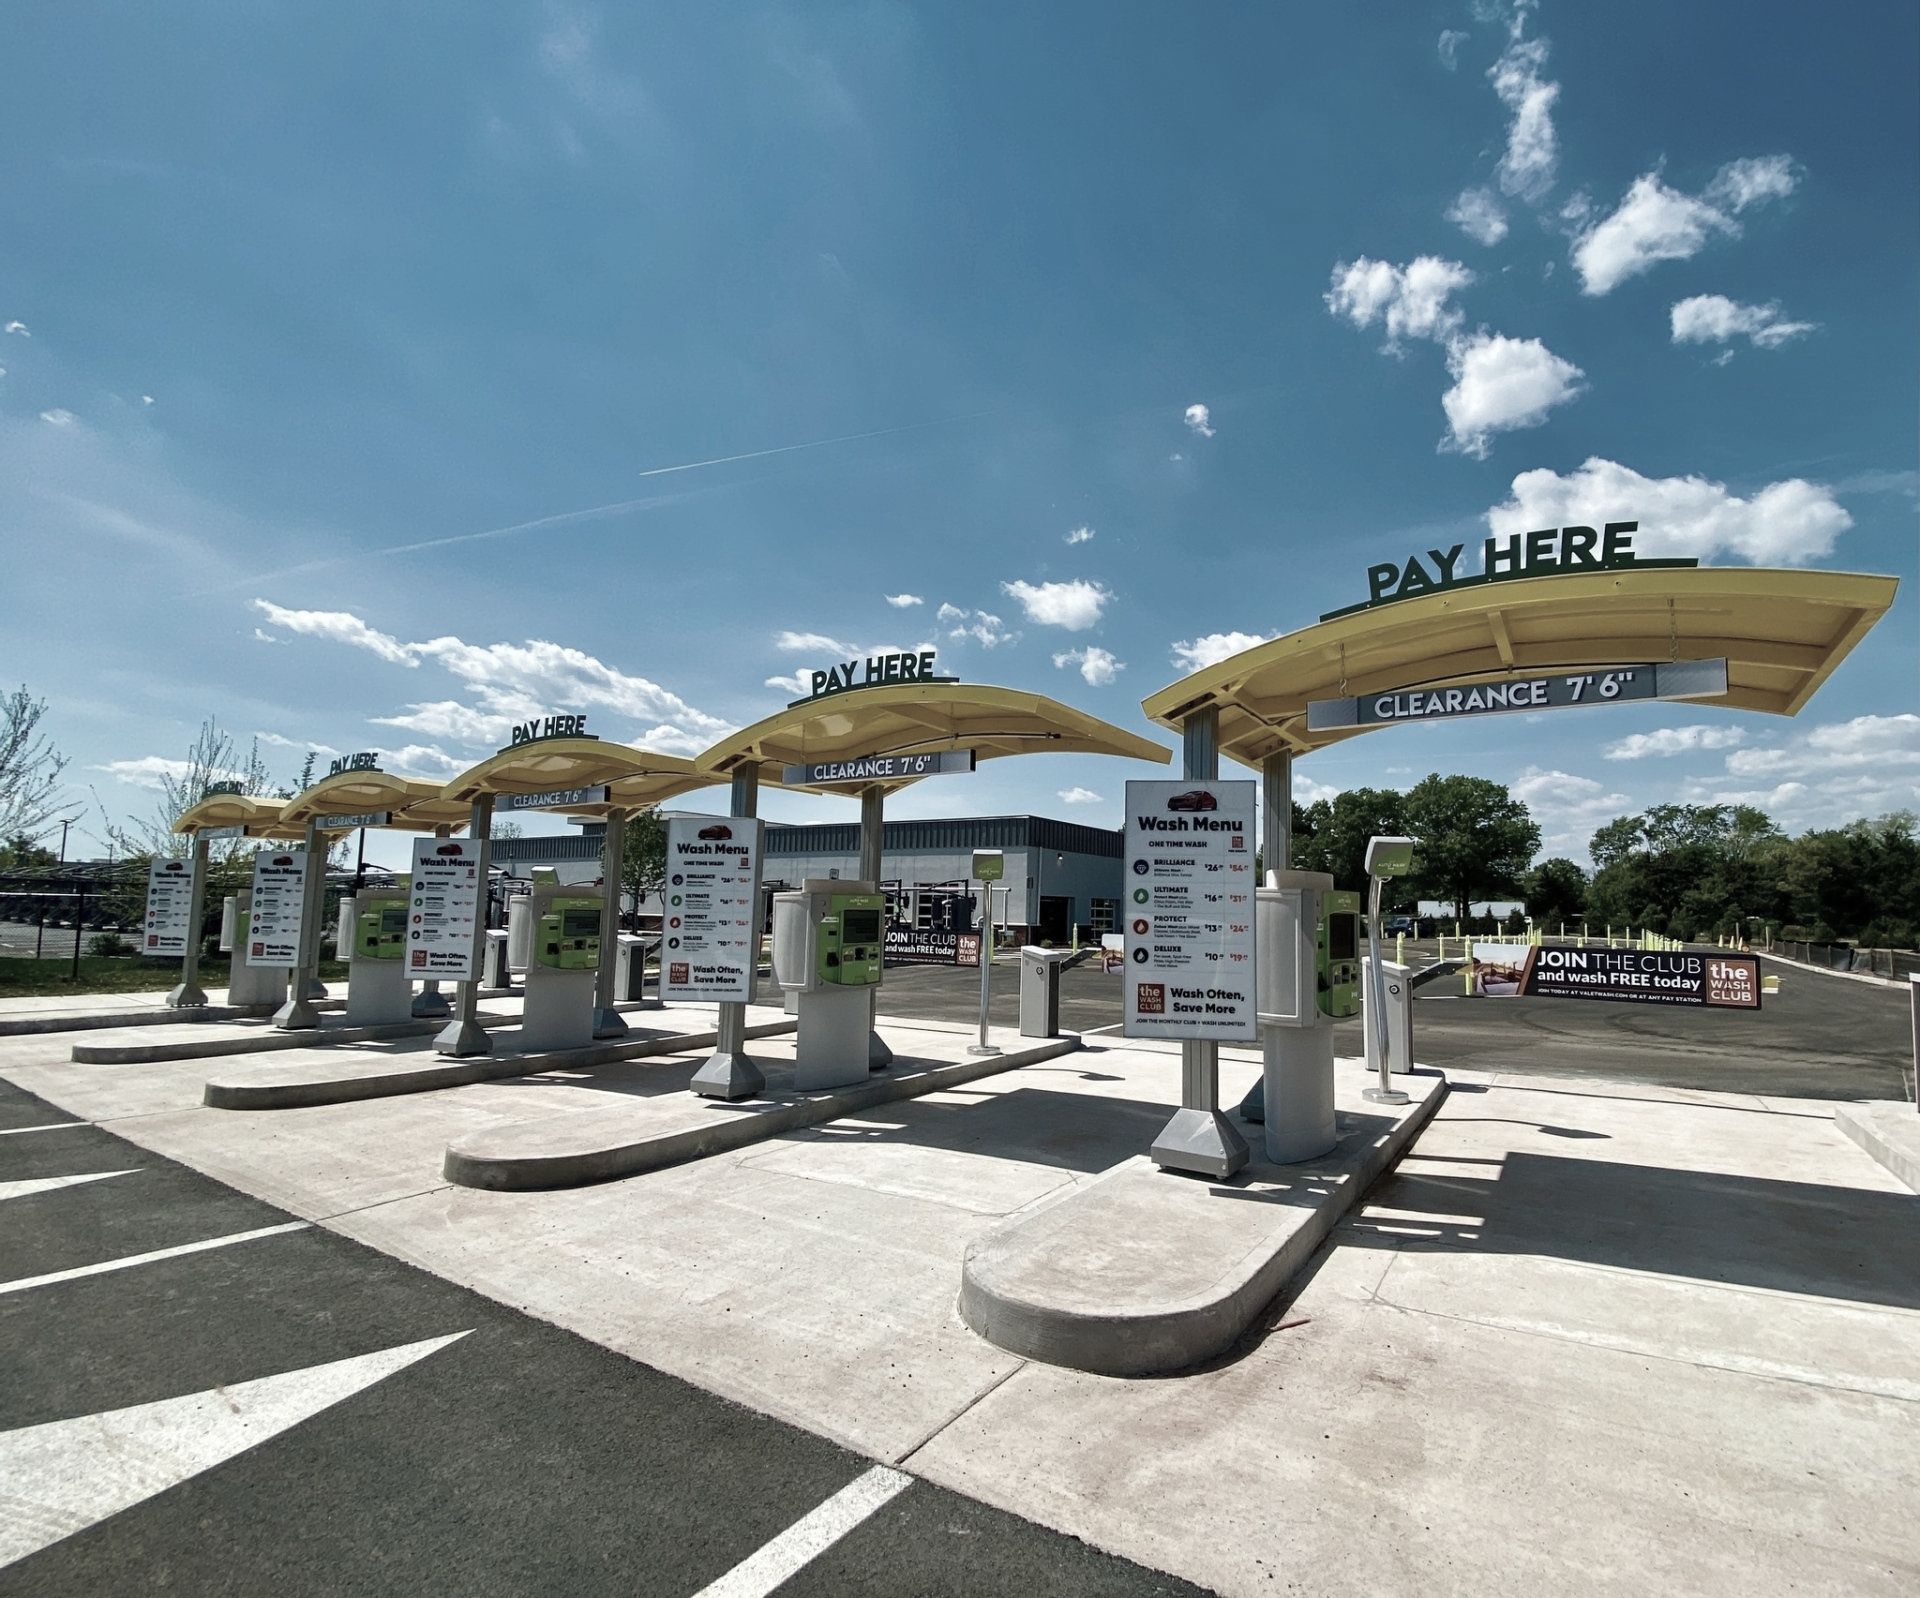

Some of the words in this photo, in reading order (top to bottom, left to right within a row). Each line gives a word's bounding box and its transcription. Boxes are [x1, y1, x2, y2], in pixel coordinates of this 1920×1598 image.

[1367, 544, 1464, 601] PAY
[1485, 521, 1638, 573] HERE
[812, 660, 858, 696] PAY
[866, 652, 935, 683] HERE
[1374, 680, 1547, 719] CLEARANCE
[512, 719, 540, 745] PAY
[544, 715, 587, 736] HERE
[330, 755, 350, 775] PAY
[350, 752, 378, 770] HERE
[814, 759, 893, 780] CLEARANCE
[513, 792, 560, 807] CLEARANCE
[1138, 816, 1189, 831] Wash
[1193, 817, 1243, 831] Menu
[677, 843, 712, 854] Wash
[715, 844, 749, 854] Menu
[420, 858, 447, 866] Wash
[449, 858, 475, 867] Menu
[885, 932, 908, 943] JOIN
[909, 933, 928, 944] THE
[930, 933, 957, 945] CLUB
[960, 937, 976, 949] the
[885, 944, 897, 952] and
[898, 945, 916, 953] wash
[916, 946, 934, 954] FREE
[935, 946, 956, 956] today
[672, 964, 686, 972] the
[1537, 951, 1587, 968] JOIN
[1591, 953, 1635, 971] THE
[1641, 956, 1700, 974] CLUB
[693, 965, 716, 973] Wash
[717, 966, 743, 975] Often,
[1710, 962, 1748, 980] the
[694, 975, 714, 983] Save
[1537, 970, 1564, 982] and
[1567, 972, 1607, 984] wash
[1610, 972, 1650, 986] FREE
[1653, 976, 1701, 991] today
[1710, 980, 1750, 990] WASH
[1140, 985, 1160, 996] the
[1170, 988, 1204, 998] Wash
[1207, 989, 1245, 1001] Often,
[1710, 990, 1752, 1002] CLUB
[1140, 1003, 1161, 1011] CLUB
[1173, 1002, 1203, 1012] Save
[1205, 1003, 1236, 1013] More
